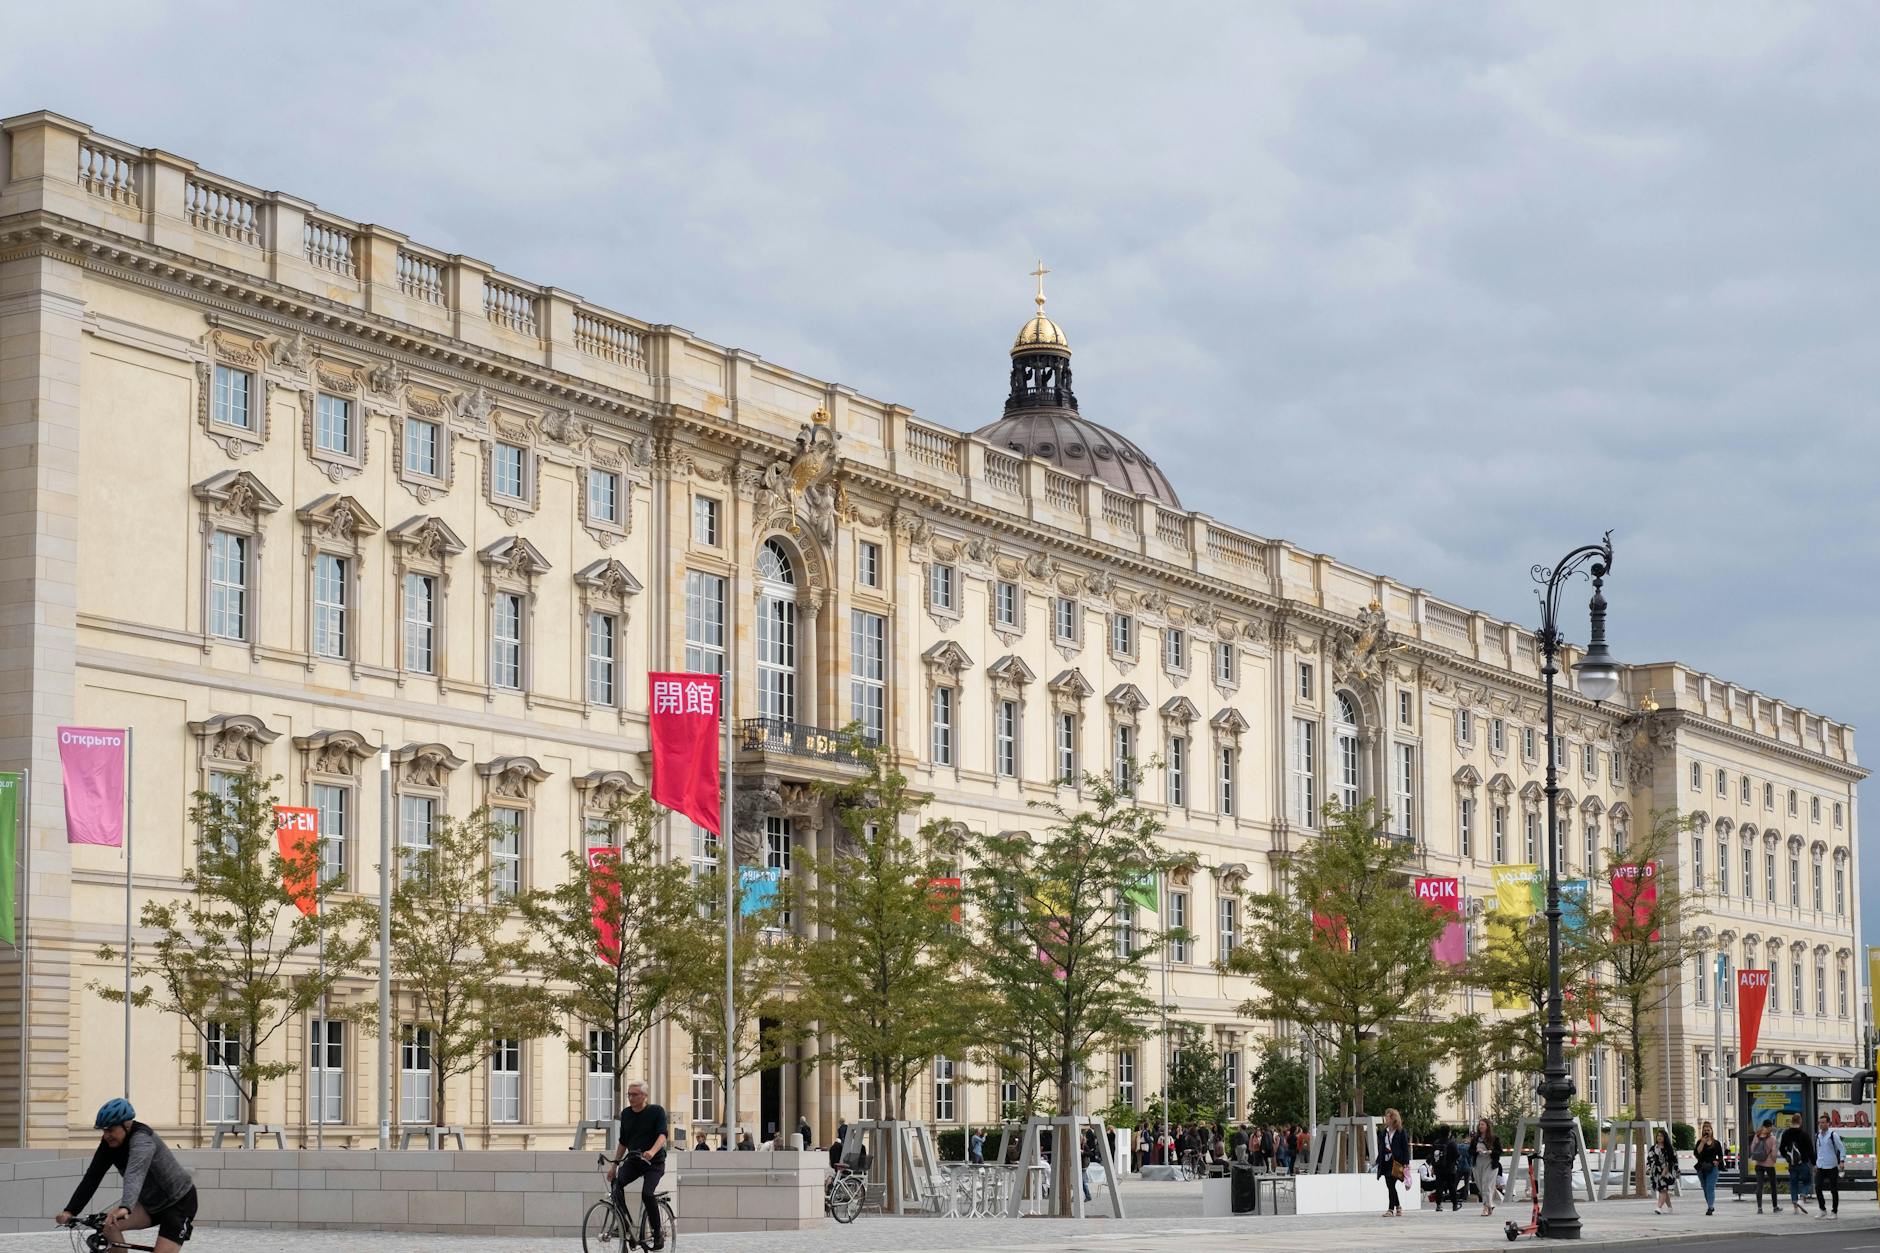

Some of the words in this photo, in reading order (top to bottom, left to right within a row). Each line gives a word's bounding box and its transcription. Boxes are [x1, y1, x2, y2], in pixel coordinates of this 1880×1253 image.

[654, 681, 714, 715] 開館
[61, 731, 121, 748] Открыто
[278, 812, 315, 832] OPEN
[1613, 866, 1653, 878] APERO
[1419, 881, 1456, 902] AÇIK
[1740, 972, 1768, 989] AÇIK
